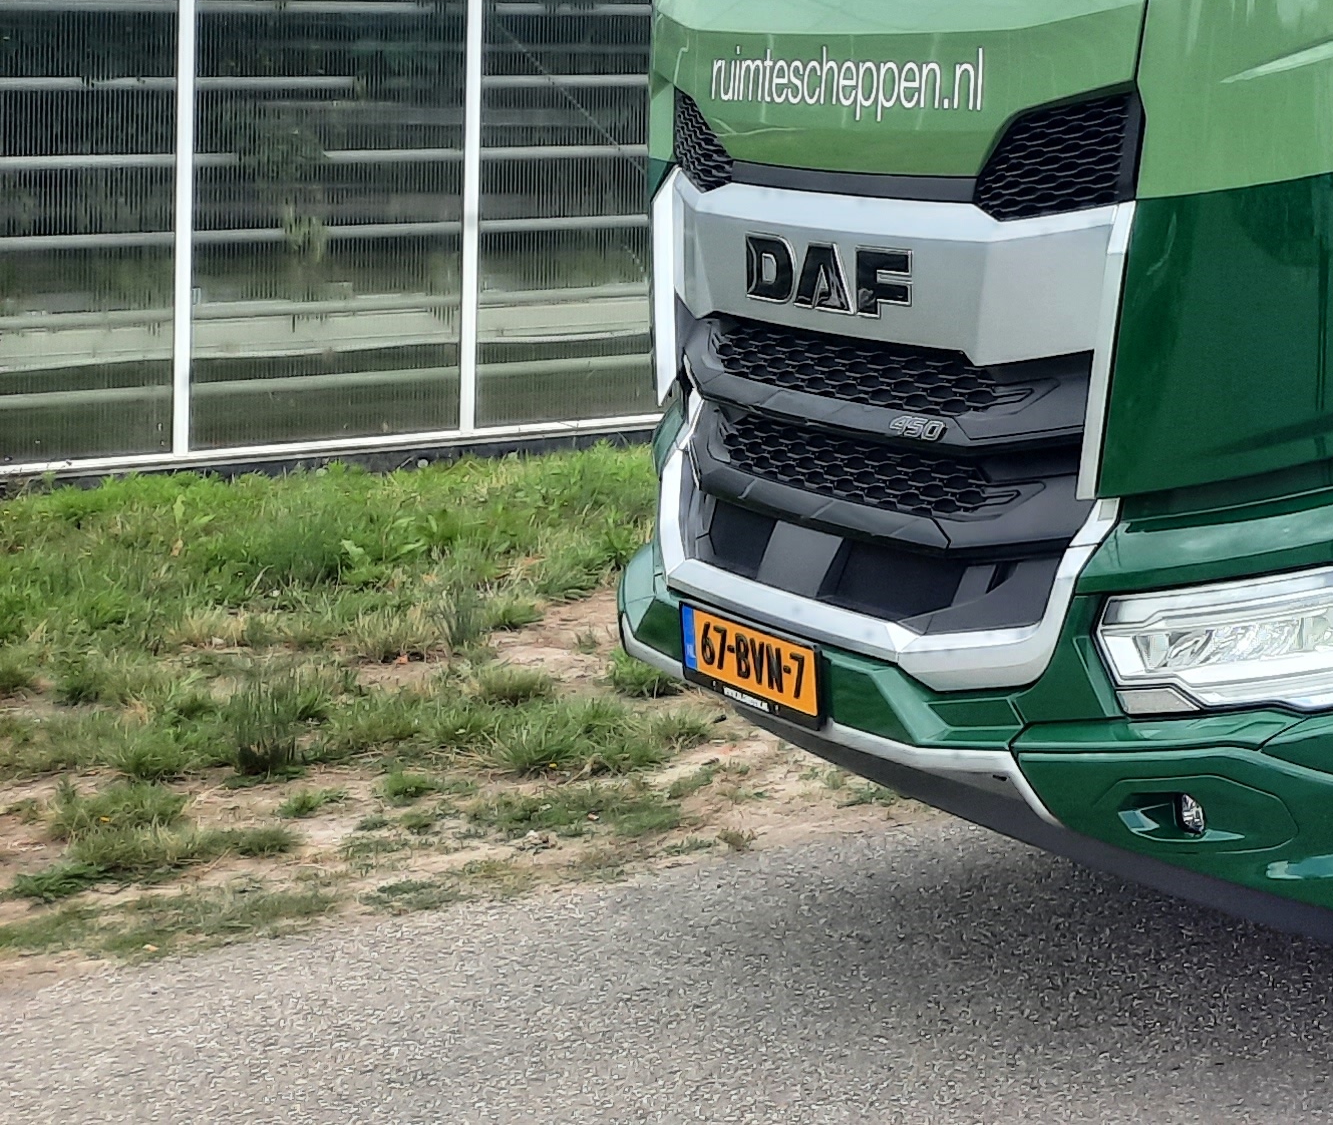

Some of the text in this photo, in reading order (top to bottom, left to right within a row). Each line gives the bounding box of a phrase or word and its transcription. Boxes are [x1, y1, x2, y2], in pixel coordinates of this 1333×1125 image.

[711, 46, 984, 121] ruimtescheppen.nl
[745, 232, 913, 317] DAF
[889, 415, 946, 441] 450
[701, 621, 805, 700] 67-BVN-7
